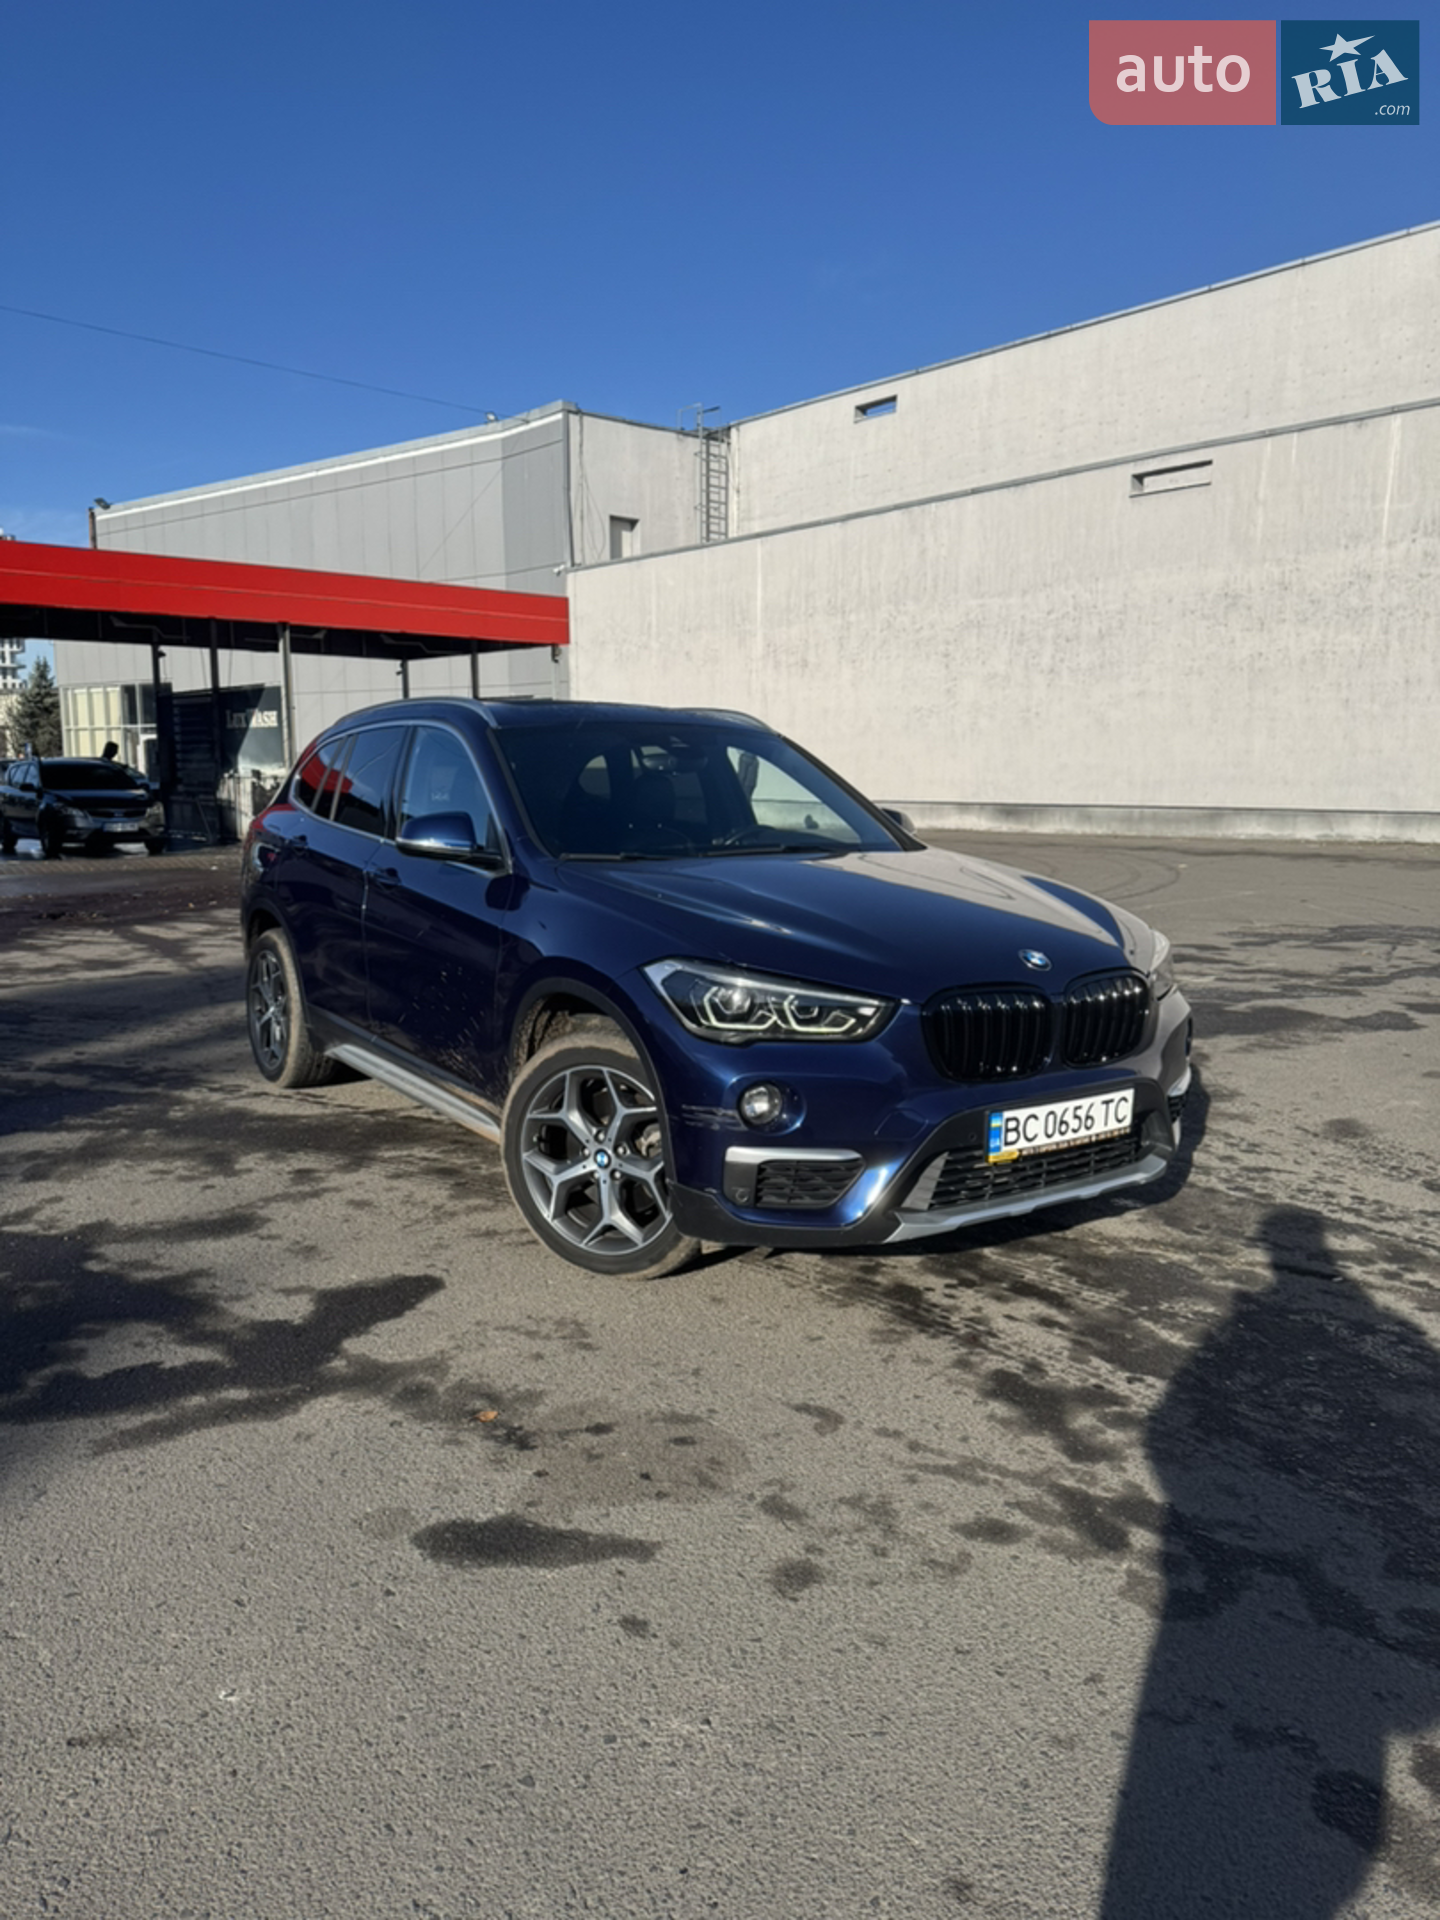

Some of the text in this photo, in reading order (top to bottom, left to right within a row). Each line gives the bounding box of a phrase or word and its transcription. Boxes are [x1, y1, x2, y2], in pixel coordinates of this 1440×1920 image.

[1004, 1114, 1039, 1147] BC
[1043, 1101, 1095, 1139] 0656
[1101, 1096, 1129, 1127] TC
